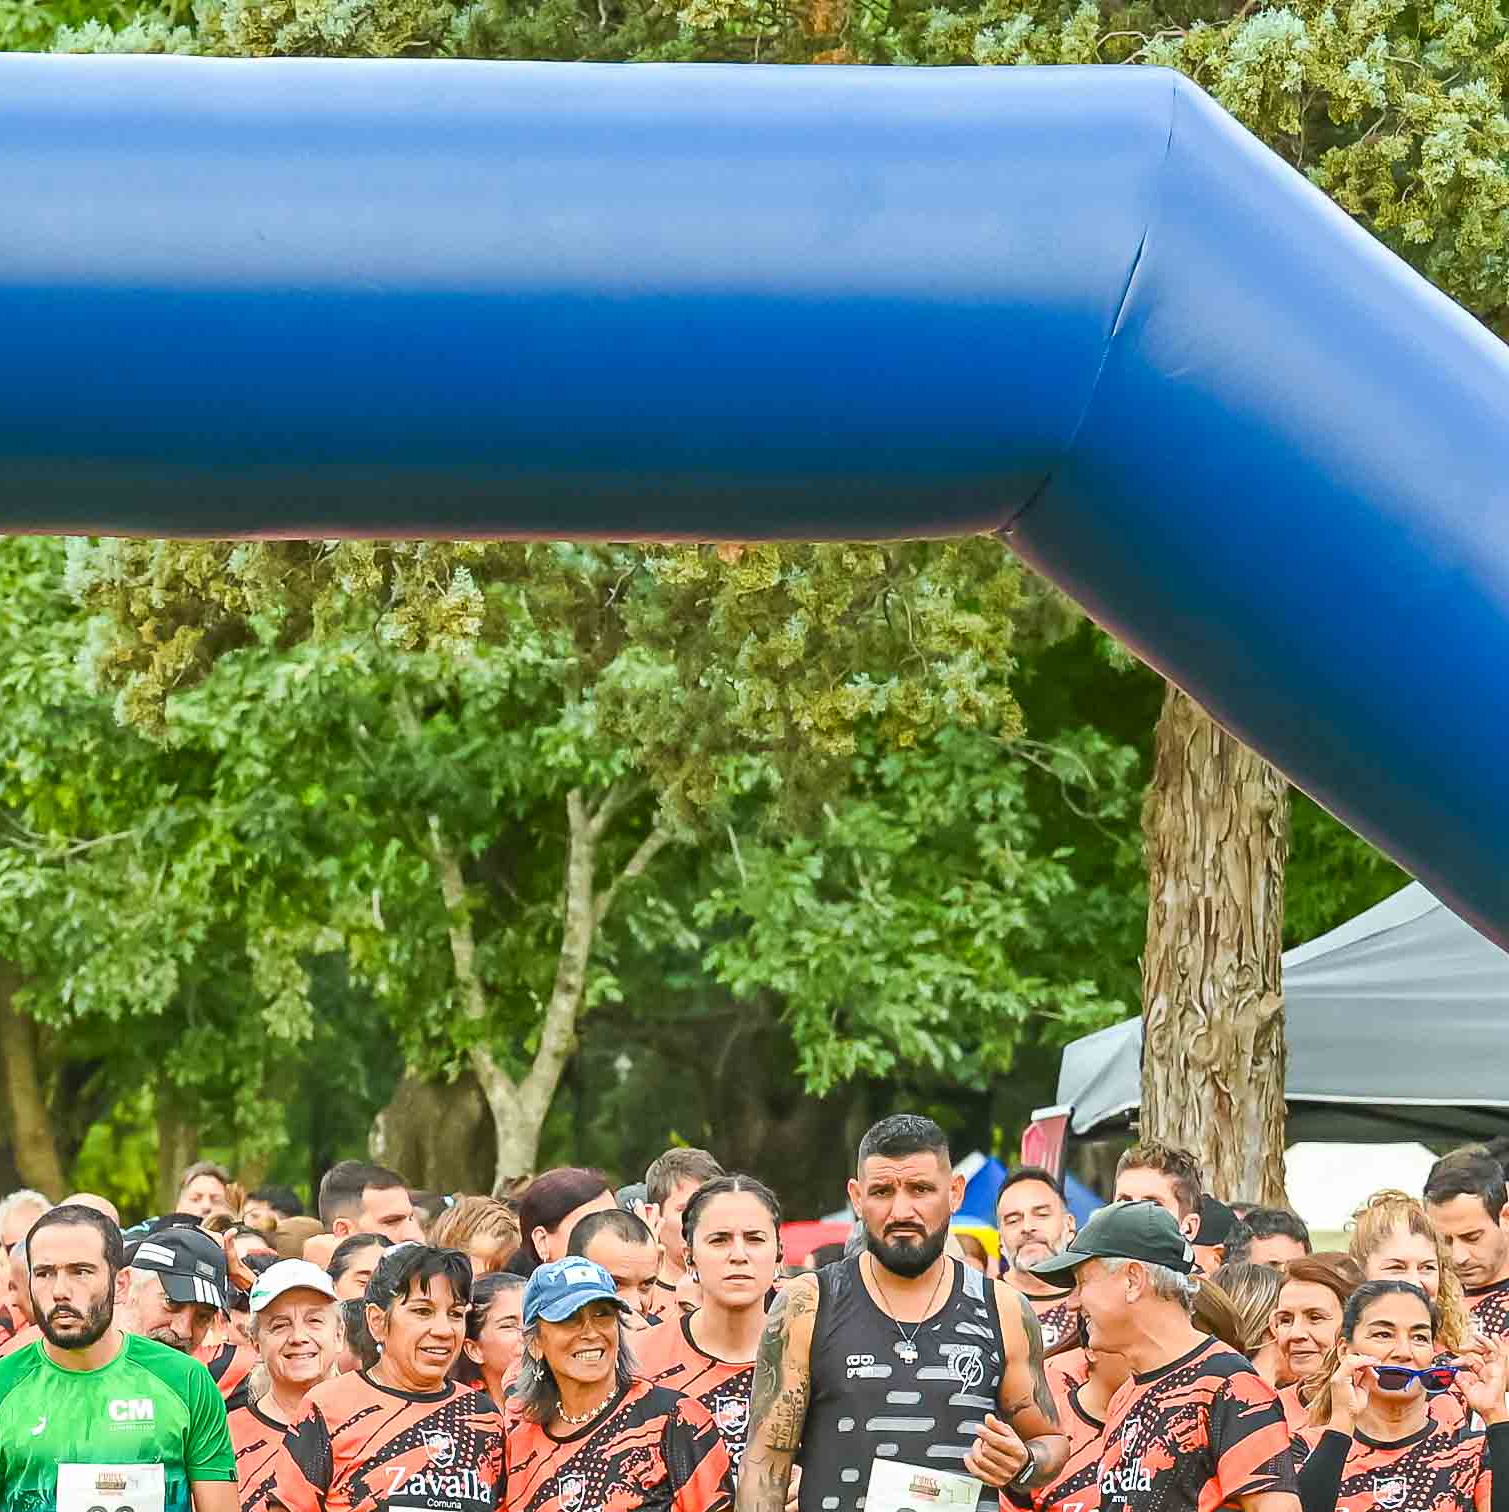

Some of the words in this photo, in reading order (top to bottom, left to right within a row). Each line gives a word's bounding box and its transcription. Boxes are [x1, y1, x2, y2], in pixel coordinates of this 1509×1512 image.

[108, 1399, 155, 1421] CM
[385, 1466, 492, 1504] Zavalla
[427, 1498, 462, 1510] Comuna
